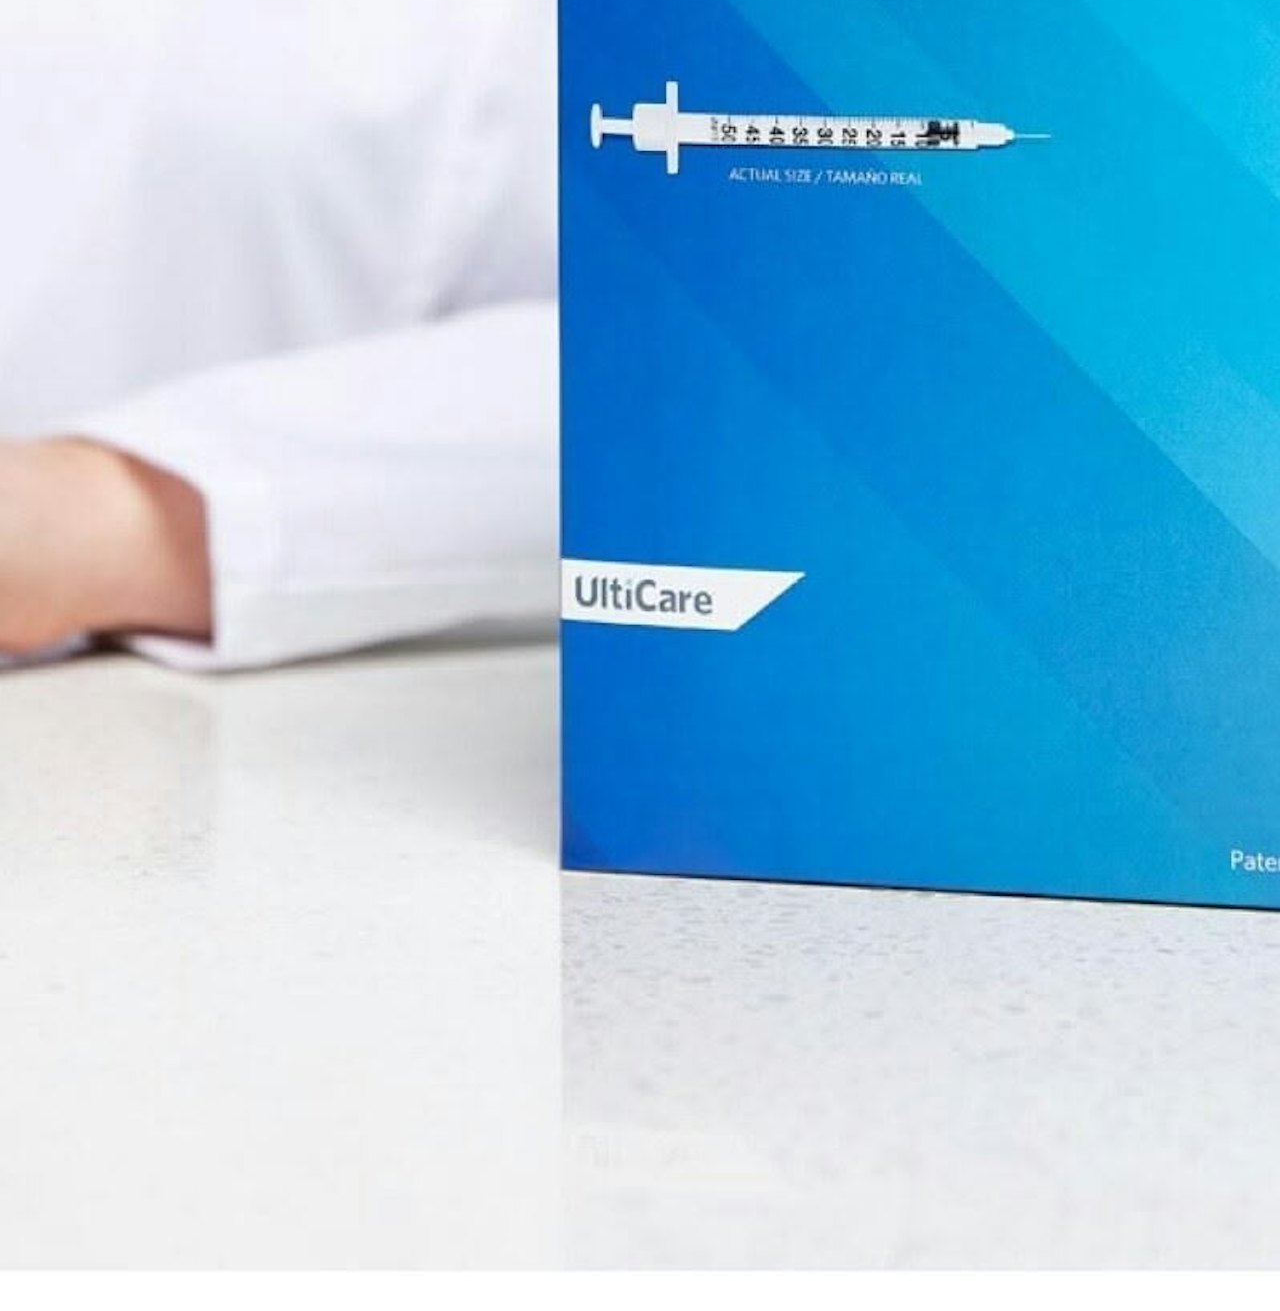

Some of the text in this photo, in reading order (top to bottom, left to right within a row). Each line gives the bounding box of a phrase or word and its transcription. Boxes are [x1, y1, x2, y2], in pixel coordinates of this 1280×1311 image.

[721, 124, 737, 143] 50
[728, 167, 782, 182] ACTUAL
[783, 168, 812, 183] SIZE
[889, 171, 922, 185] REAL
[575, 575, 713, 615] UltiCare
